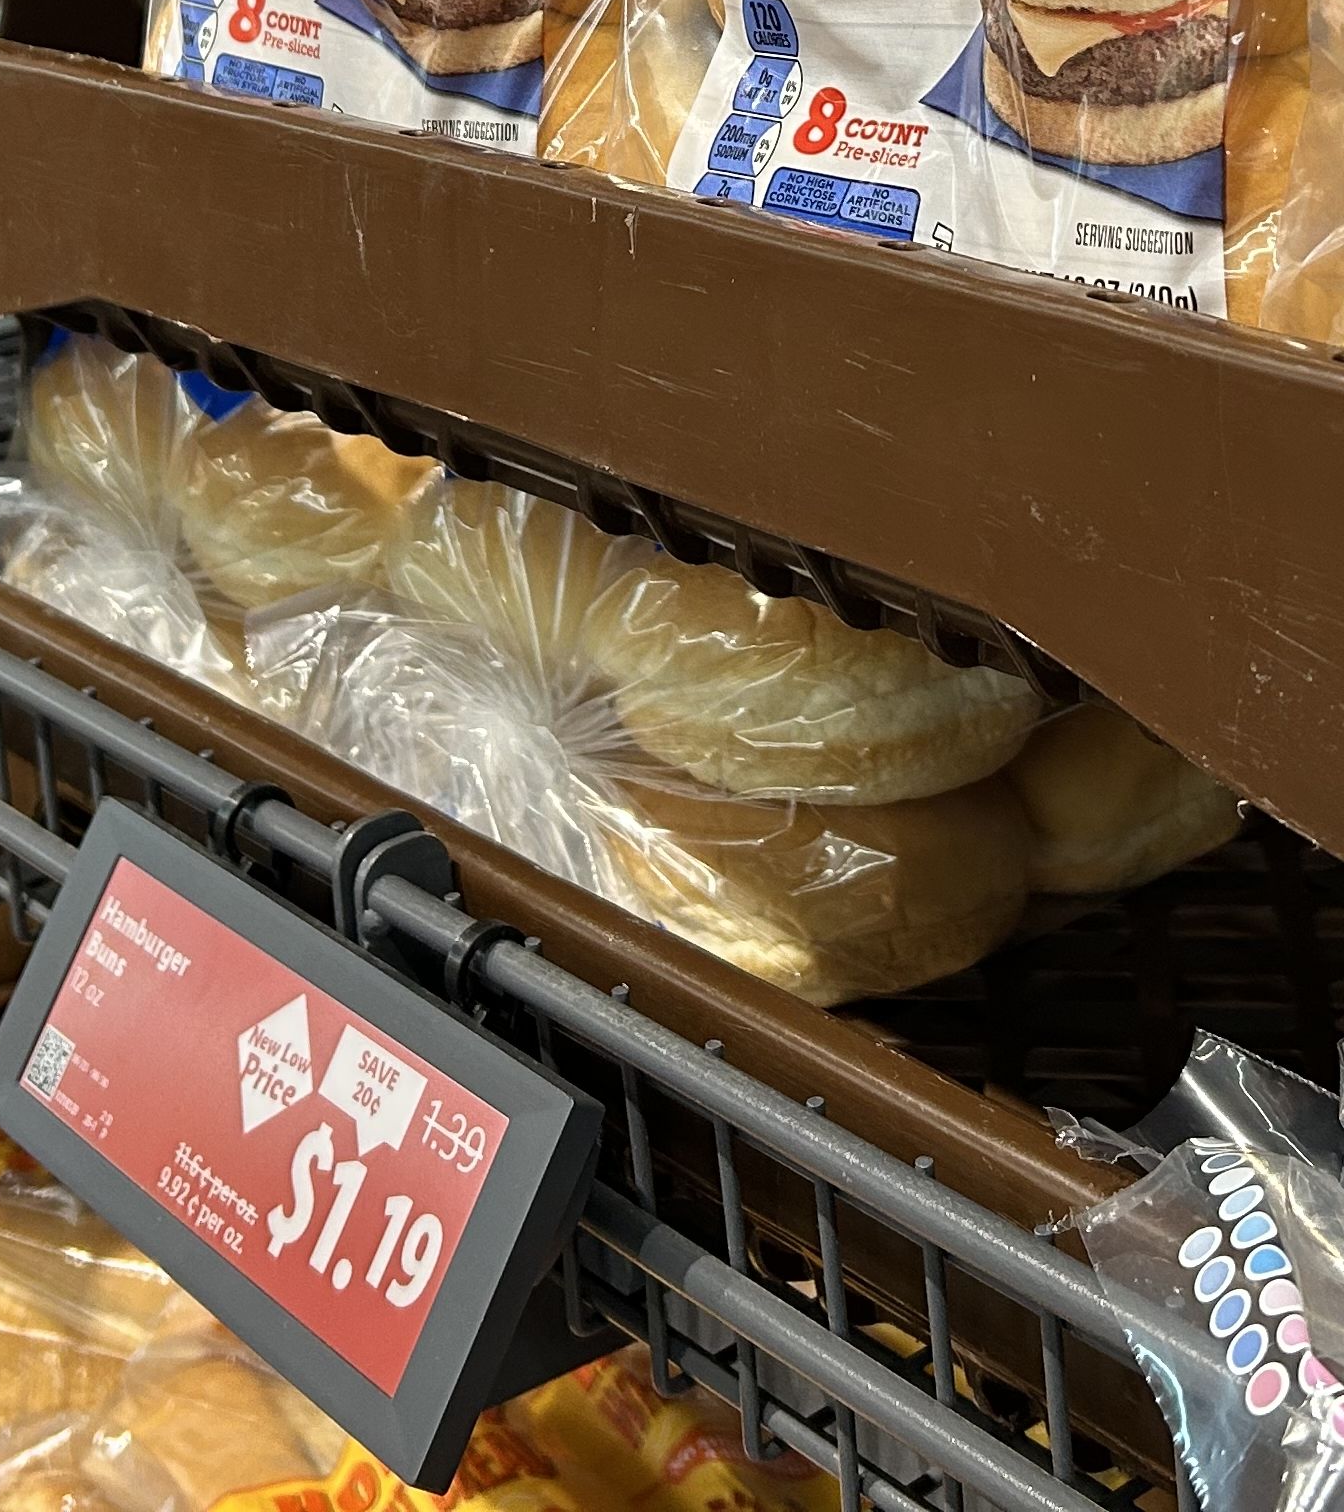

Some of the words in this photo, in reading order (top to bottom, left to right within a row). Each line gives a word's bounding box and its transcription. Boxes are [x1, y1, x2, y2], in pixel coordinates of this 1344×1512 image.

[266, 10, 322, 40] COUNT
[750, 1, 780, 32] 120
[262, 30, 321, 60] Pre-sliced
[753, 30, 791, 49] CALORIES
[759, 68, 773, 87] 0g
[463, 120, 520, 142] SUGGESTION
[720, 123, 755, 148] 200mg
[792, 86, 848, 156] 8
[844, 117, 929, 148] COUNT
[714, 143, 748, 162] SODIUM
[832, 140, 922, 169] Pre-sliced
[778, 181, 836, 202] FRUCTOSE
[787, 173, 805, 185] NO
[807, 175, 834, 190] HIGH
[872, 187, 890, 200] NO
[769, 192, 800, 206] CORN
[801, 197, 838, 213] SYRUP
[846, 194, 911, 217] ARTIFICIAL
[848, 206, 903, 226] FLAVORS
[1075, 222, 1122, 249] SERVING
[1125, 227, 1194, 255] SUGGESTION
[100, 896, 192, 977] Hamburger
[85, 930, 128, 978] Buns
[71, 966, 88, 994] 12
[85, 984, 105, 1007] oz
[248, 1025, 281, 1057] New
[280, 1043, 312, 1075] Low
[243, 1052, 297, 1106] Price
[357, 1050, 401, 1092] SAVE
[352, 1081, 381, 1116] 20¢
[422, 1100, 487, 1174] 1.39
[212, 1176, 239, 1206] per
[158, 1166, 191, 1205] 9.92
[198, 1203, 224, 1234] per
[223, 1225, 243, 1254] oz.
[267, 1121, 444, 1307] $1.19
